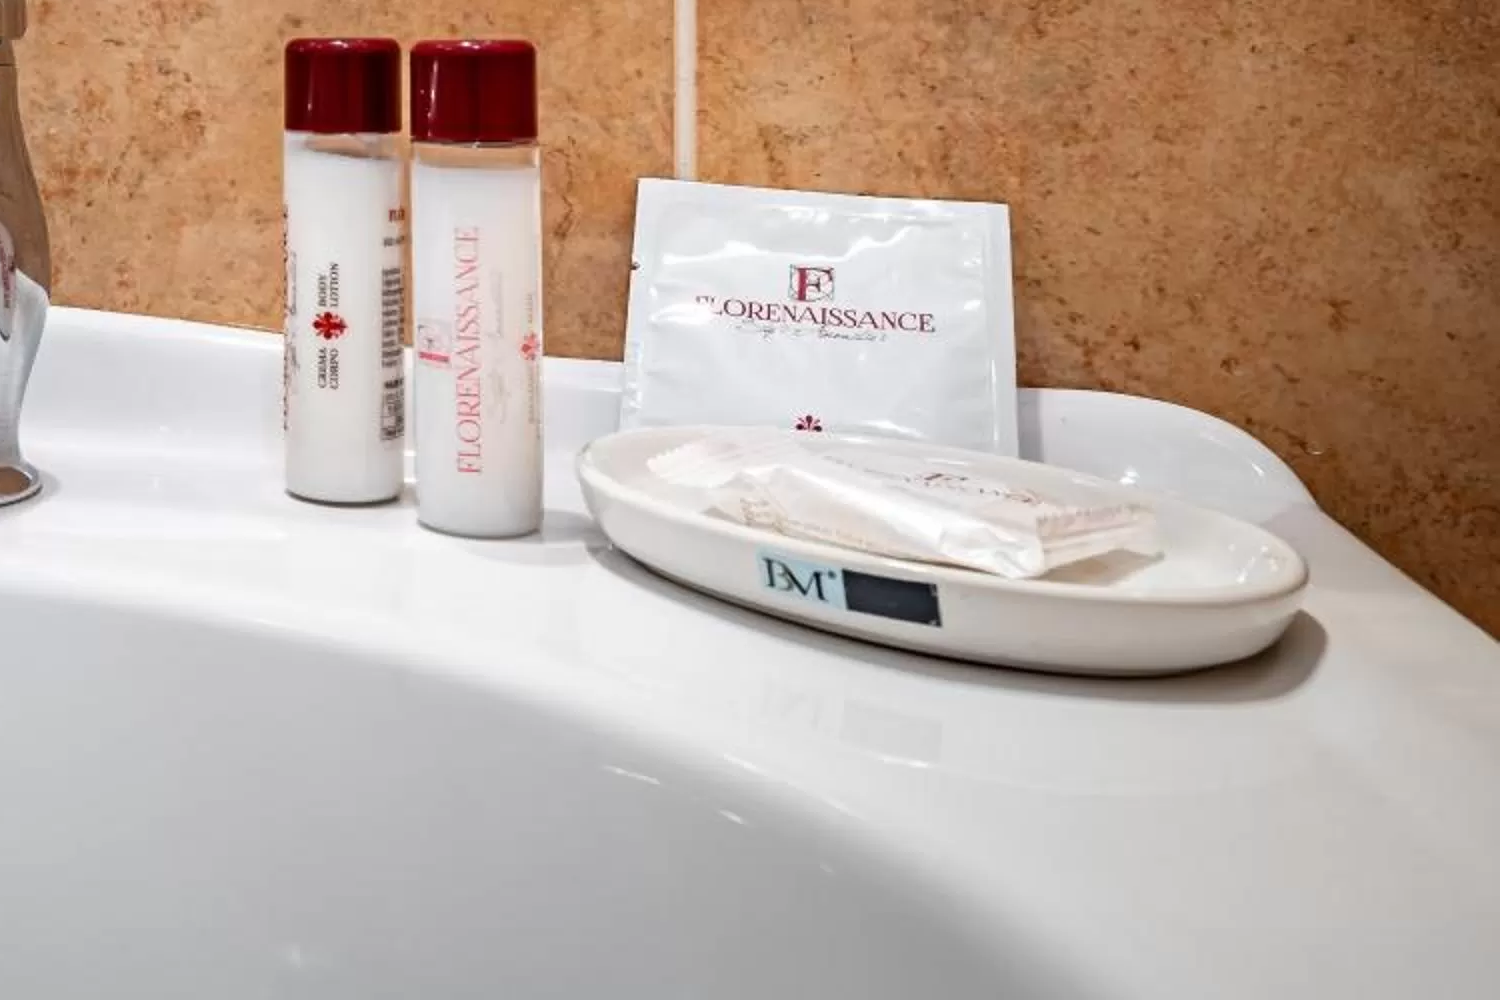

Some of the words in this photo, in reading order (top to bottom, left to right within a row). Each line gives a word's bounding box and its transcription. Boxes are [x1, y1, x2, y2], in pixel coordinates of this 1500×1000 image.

[317, 273, 328, 308] BODY
[329, 262, 340, 308] LOTION
[317, 347, 328, 389] CREMA
[329, 347, 340, 390] CORPO
[453, 226, 483, 475] FLORENAISSANCE
